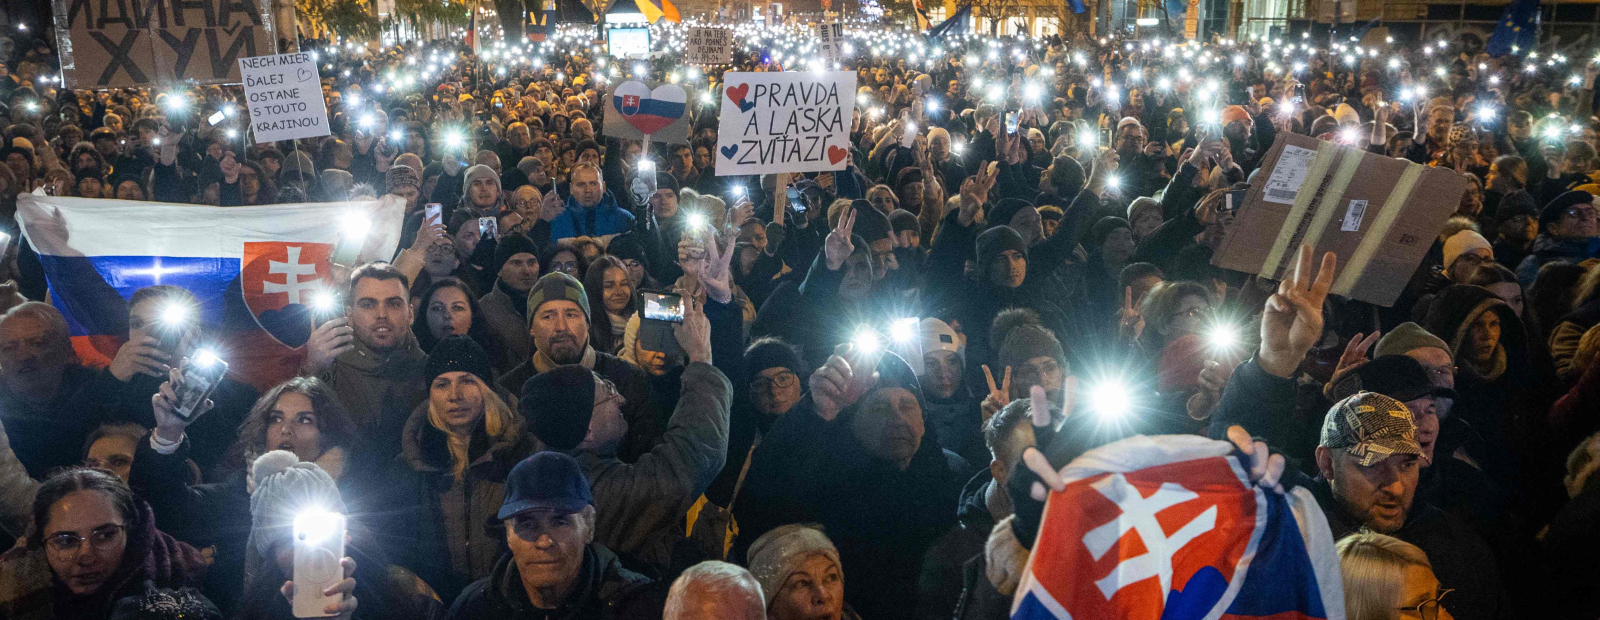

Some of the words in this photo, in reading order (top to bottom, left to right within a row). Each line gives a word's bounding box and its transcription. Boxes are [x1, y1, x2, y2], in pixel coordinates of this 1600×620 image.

[821, 24, 829, 42] sme
[88, 21, 257, 86] ХУЙ
[242, 57, 276, 69] NECH
[280, 53, 310, 65] MIER
[247, 74, 284, 87] ĎALEJ
[250, 88, 300, 102] OSTANE
[753, 82, 839, 108] PRAVDA
[253, 107, 261, 117] S
[264, 102, 307, 115] TOUTO
[256, 117, 319, 132] KRAJINOU
[744, 111, 759, 136] A
[769, 106, 843, 136] LÁSKA
[736, 134, 833, 165] ZVÍŤAZÍ
[1315, 174, 1331, 197] goods
